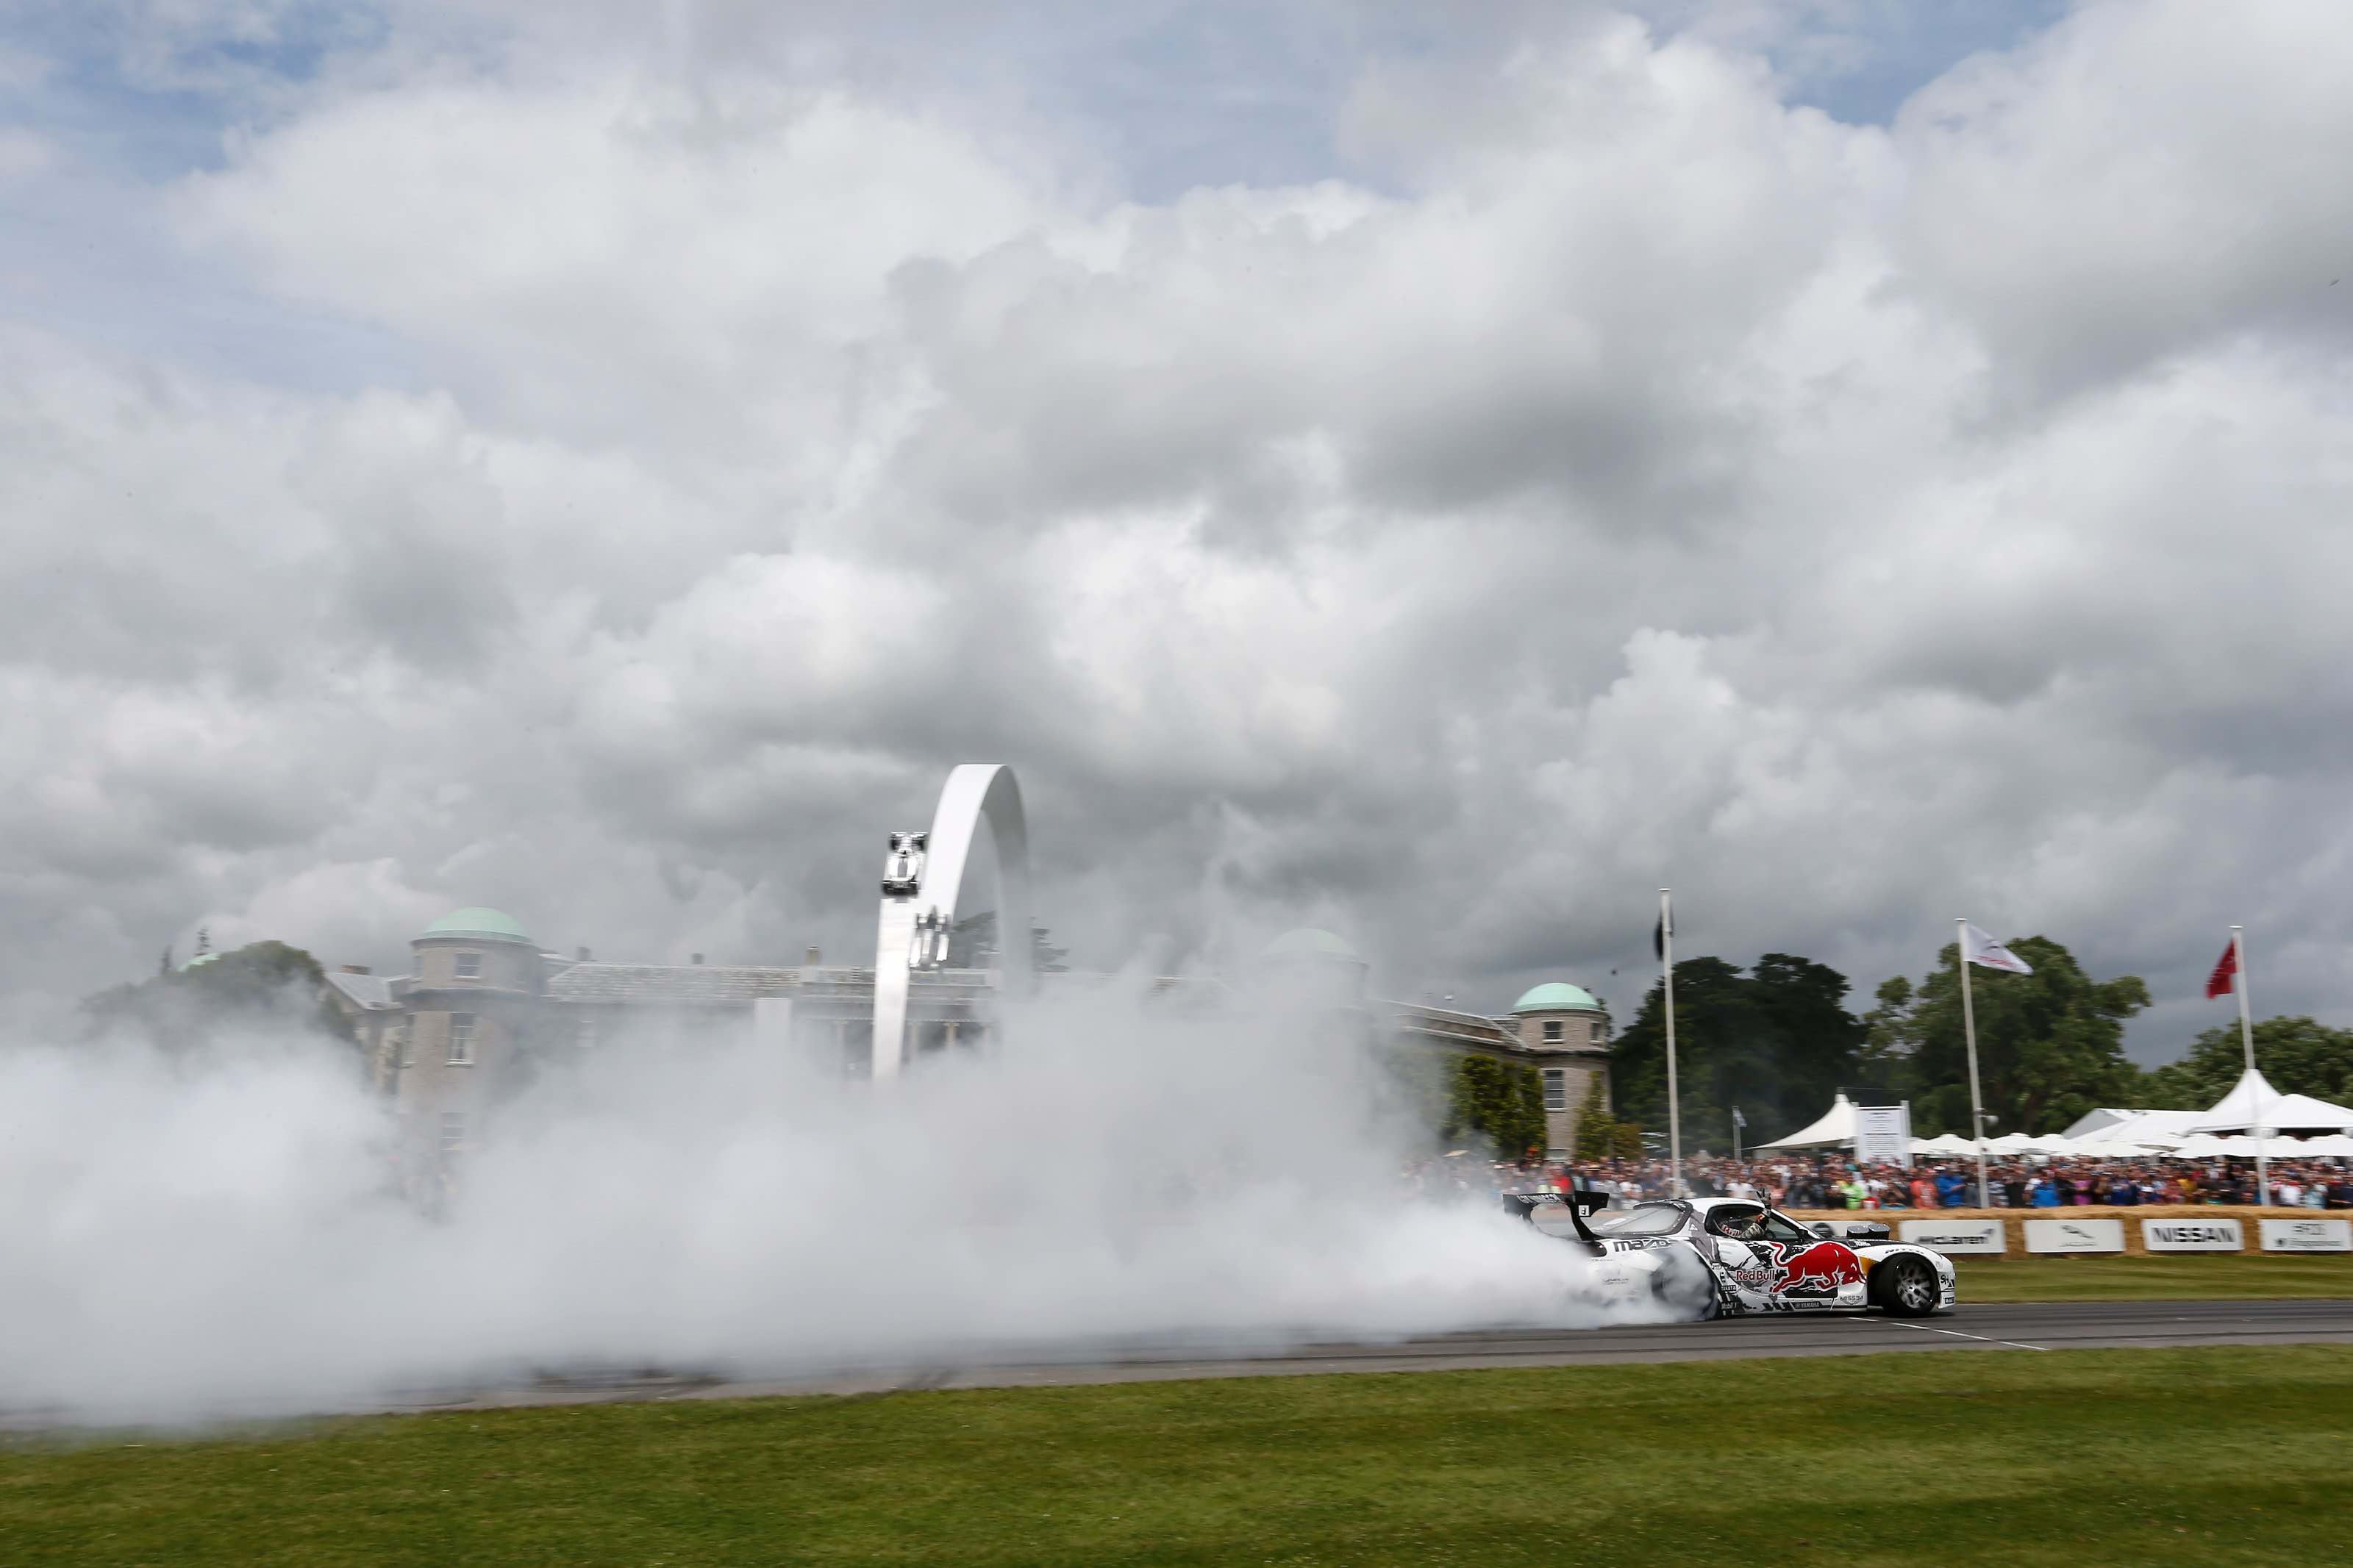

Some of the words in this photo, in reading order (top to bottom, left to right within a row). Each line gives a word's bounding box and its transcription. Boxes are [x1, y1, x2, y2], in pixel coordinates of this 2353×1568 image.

[1915, 1235, 1989, 1245] McLaren
[2152, 1227, 2235, 1242] NISSAN
[1613, 1239, 1672, 1251] mazd
[1736, 1270, 1755, 1280] Red
[1757, 1270, 1775, 1280] Bull
